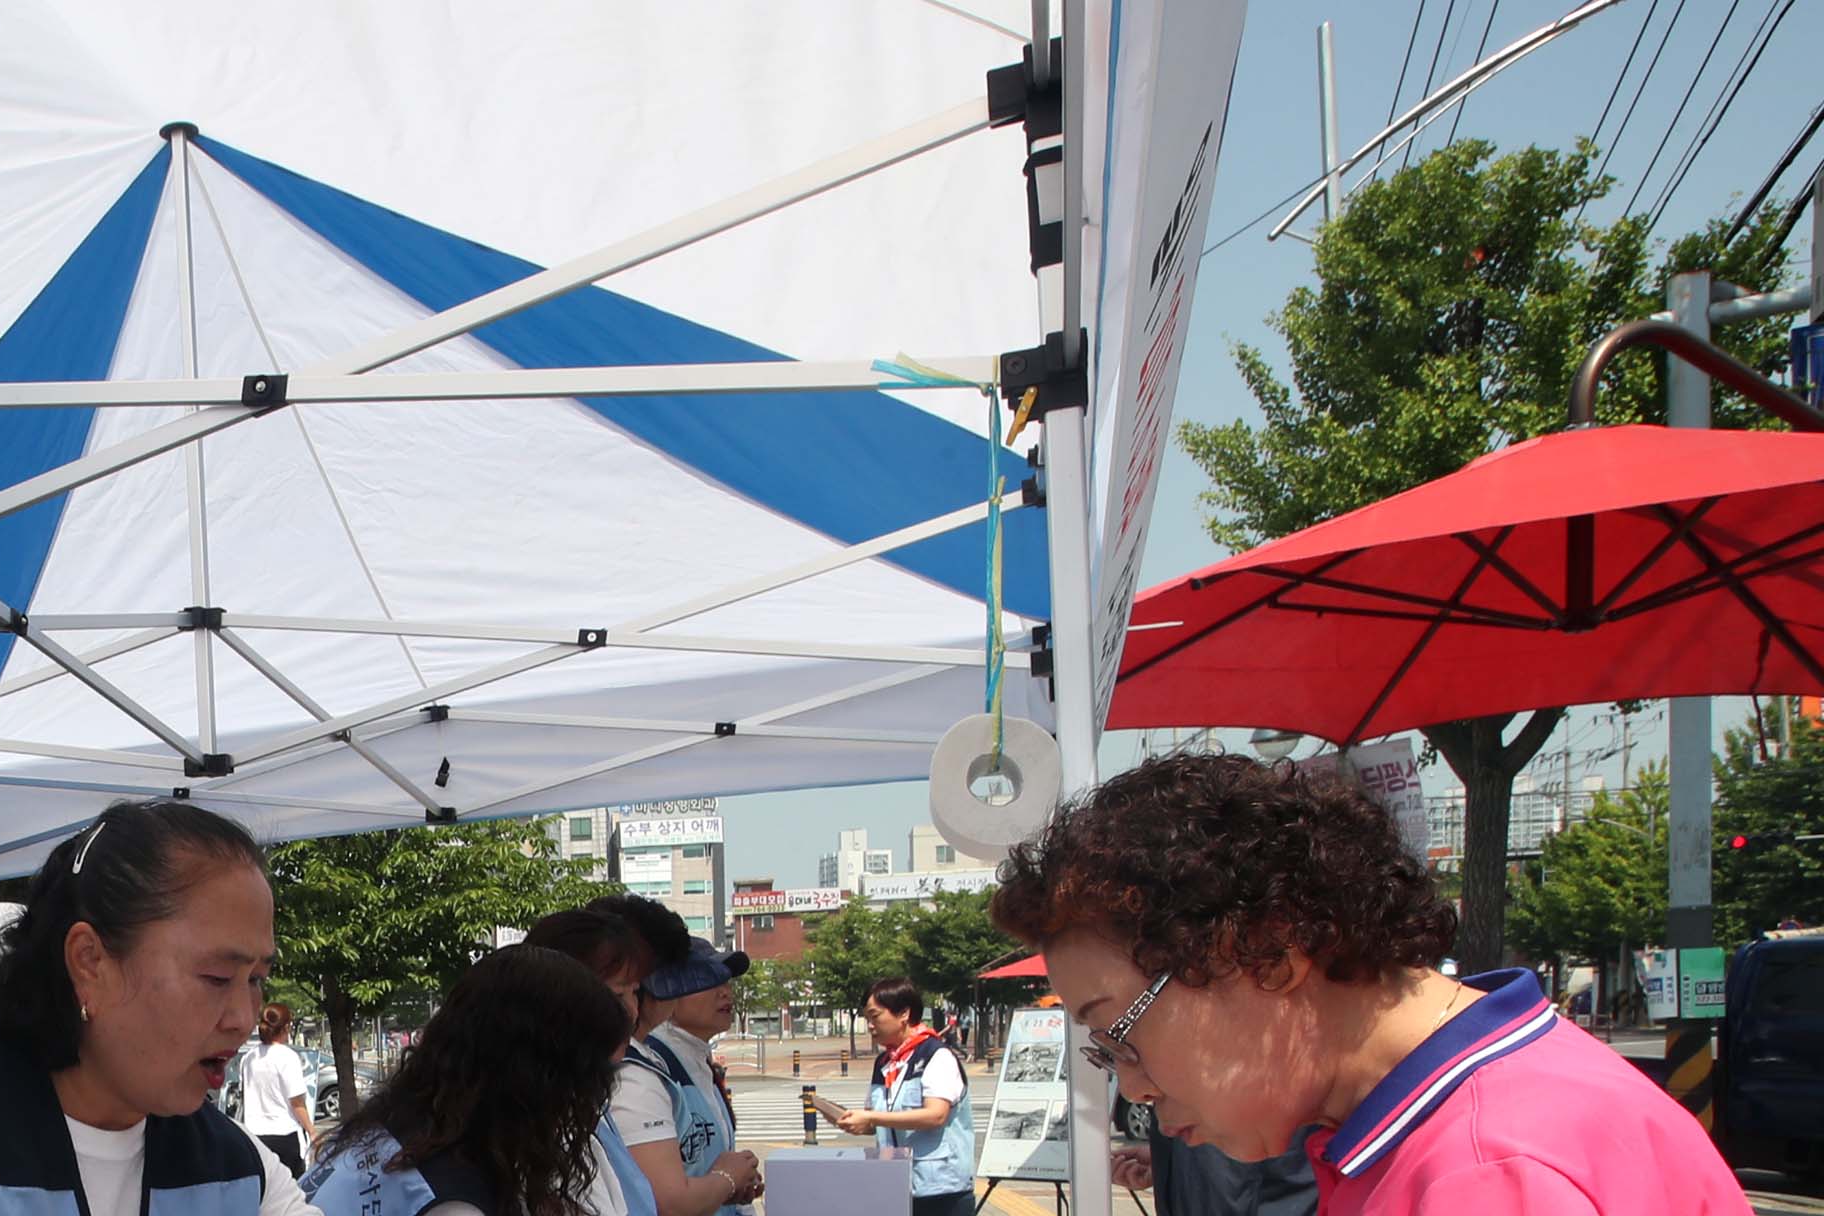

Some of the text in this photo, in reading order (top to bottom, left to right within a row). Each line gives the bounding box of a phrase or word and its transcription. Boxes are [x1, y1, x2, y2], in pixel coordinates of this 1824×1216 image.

[624, 818, 720, 837] 수부 상지 어깨
